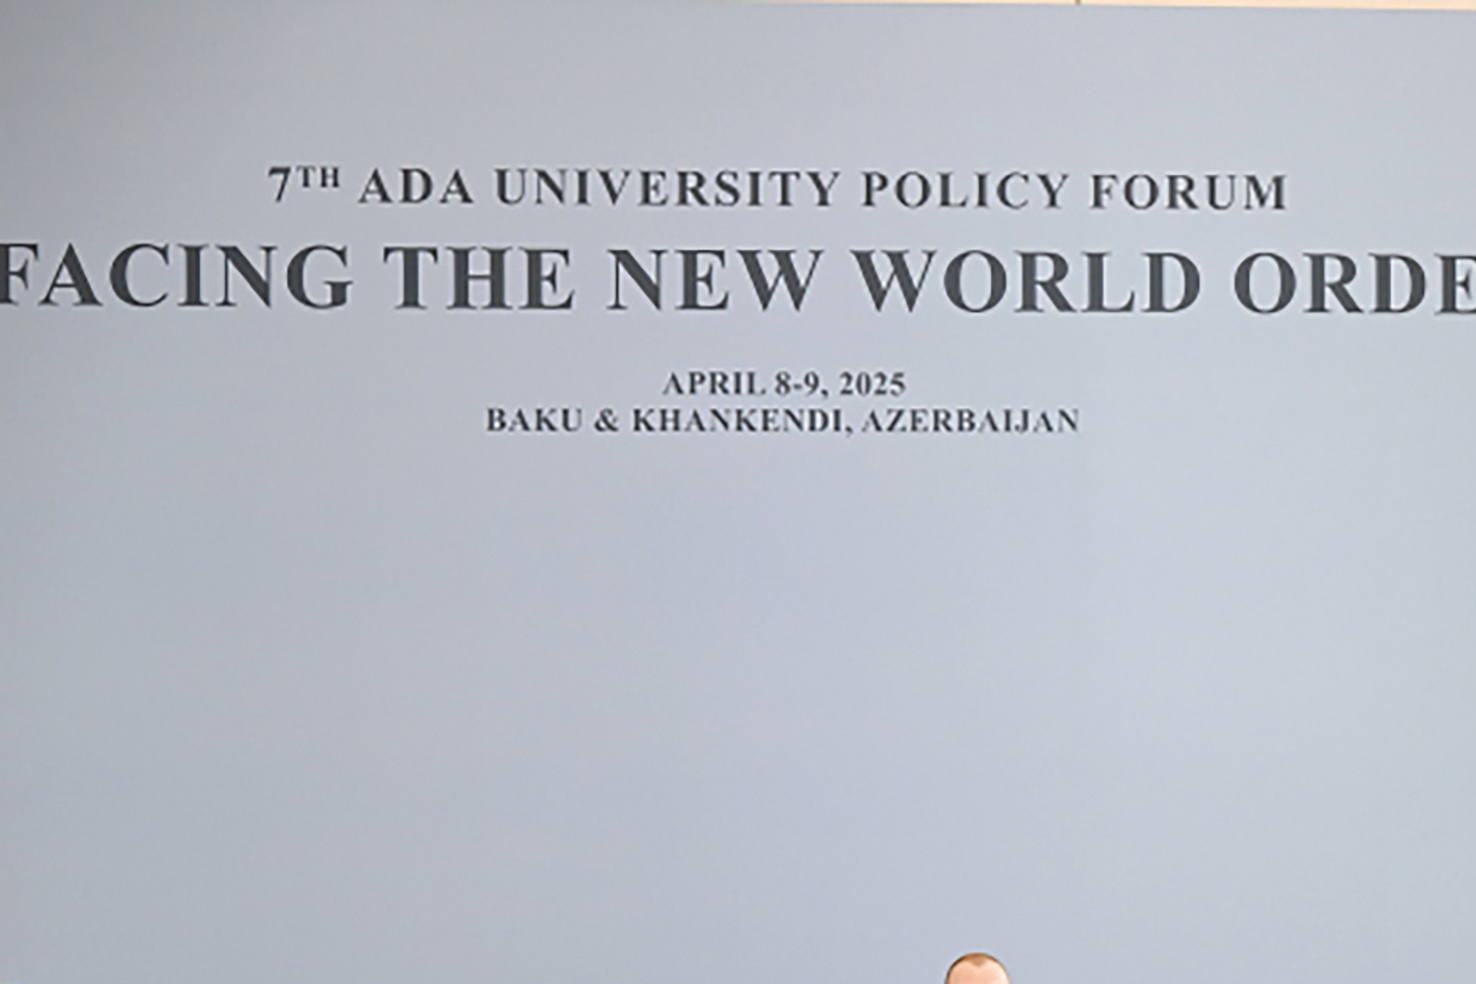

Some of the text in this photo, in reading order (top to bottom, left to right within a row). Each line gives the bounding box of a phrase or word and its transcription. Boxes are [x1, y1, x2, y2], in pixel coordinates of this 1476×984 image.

[357, 168, 475, 205] ADA
[495, 168, 841, 208] UNIVERSITY
[861, 171, 1070, 211] POLICY
[1090, 174, 1286, 211] FORUM
[0, 242, 354, 311] FACING
[383, 246, 576, 311] THE
[606, 248, 826, 313] NEW
[849, 249, 1201, 314] WORLD
[662, 370, 907, 399] APRIL 8-9, 2025
[486, 407, 1079, 437] BAKU & KHANKENDI, AZERBAIJAN
